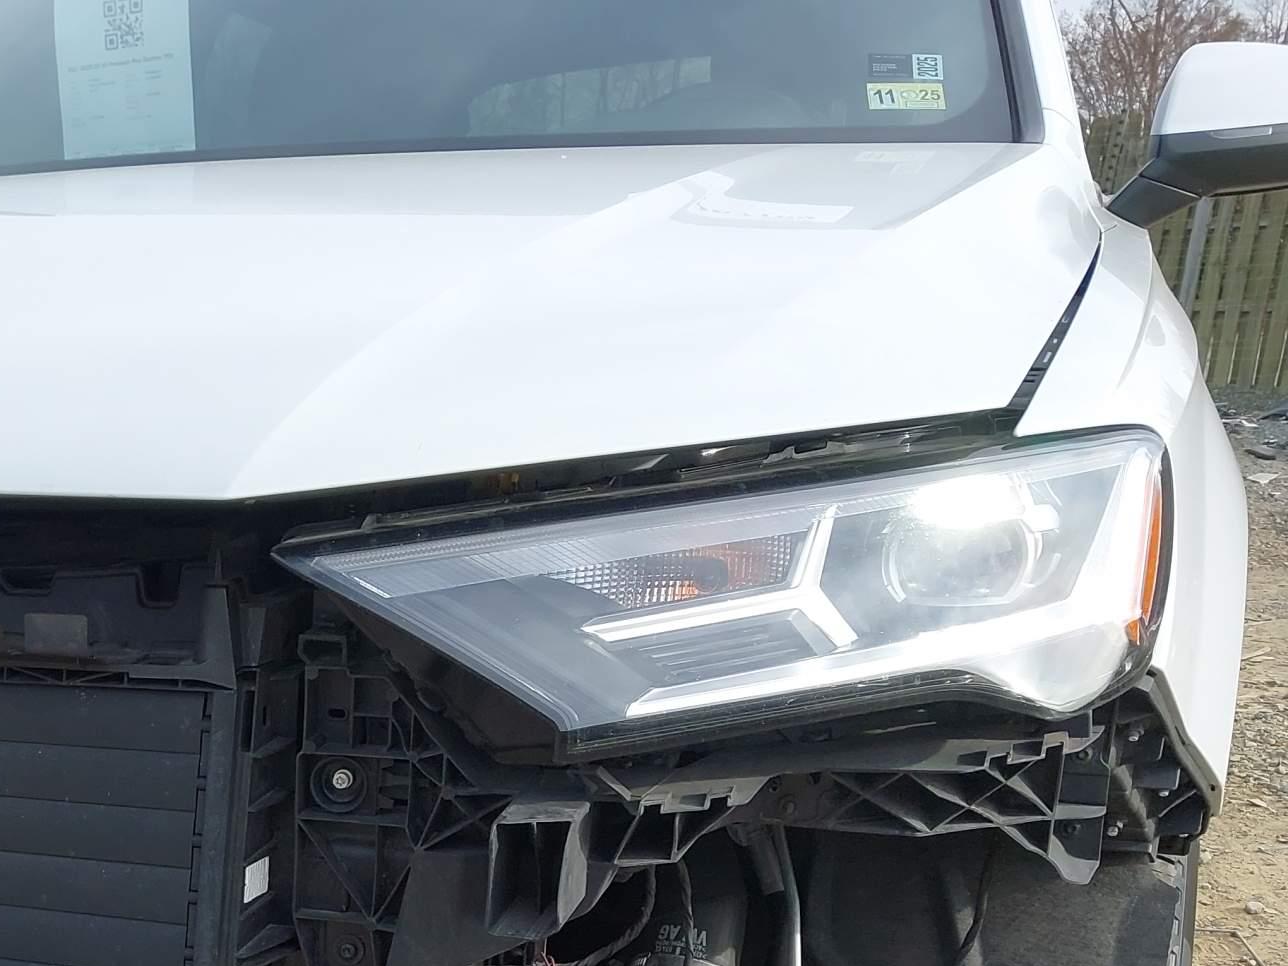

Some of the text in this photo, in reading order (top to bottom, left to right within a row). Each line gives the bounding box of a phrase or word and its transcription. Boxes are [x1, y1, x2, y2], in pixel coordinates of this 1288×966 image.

[916, 56, 939, 78] 2025
[873, 88, 941, 105] 11 25
[657, 924, 681, 940] AG
